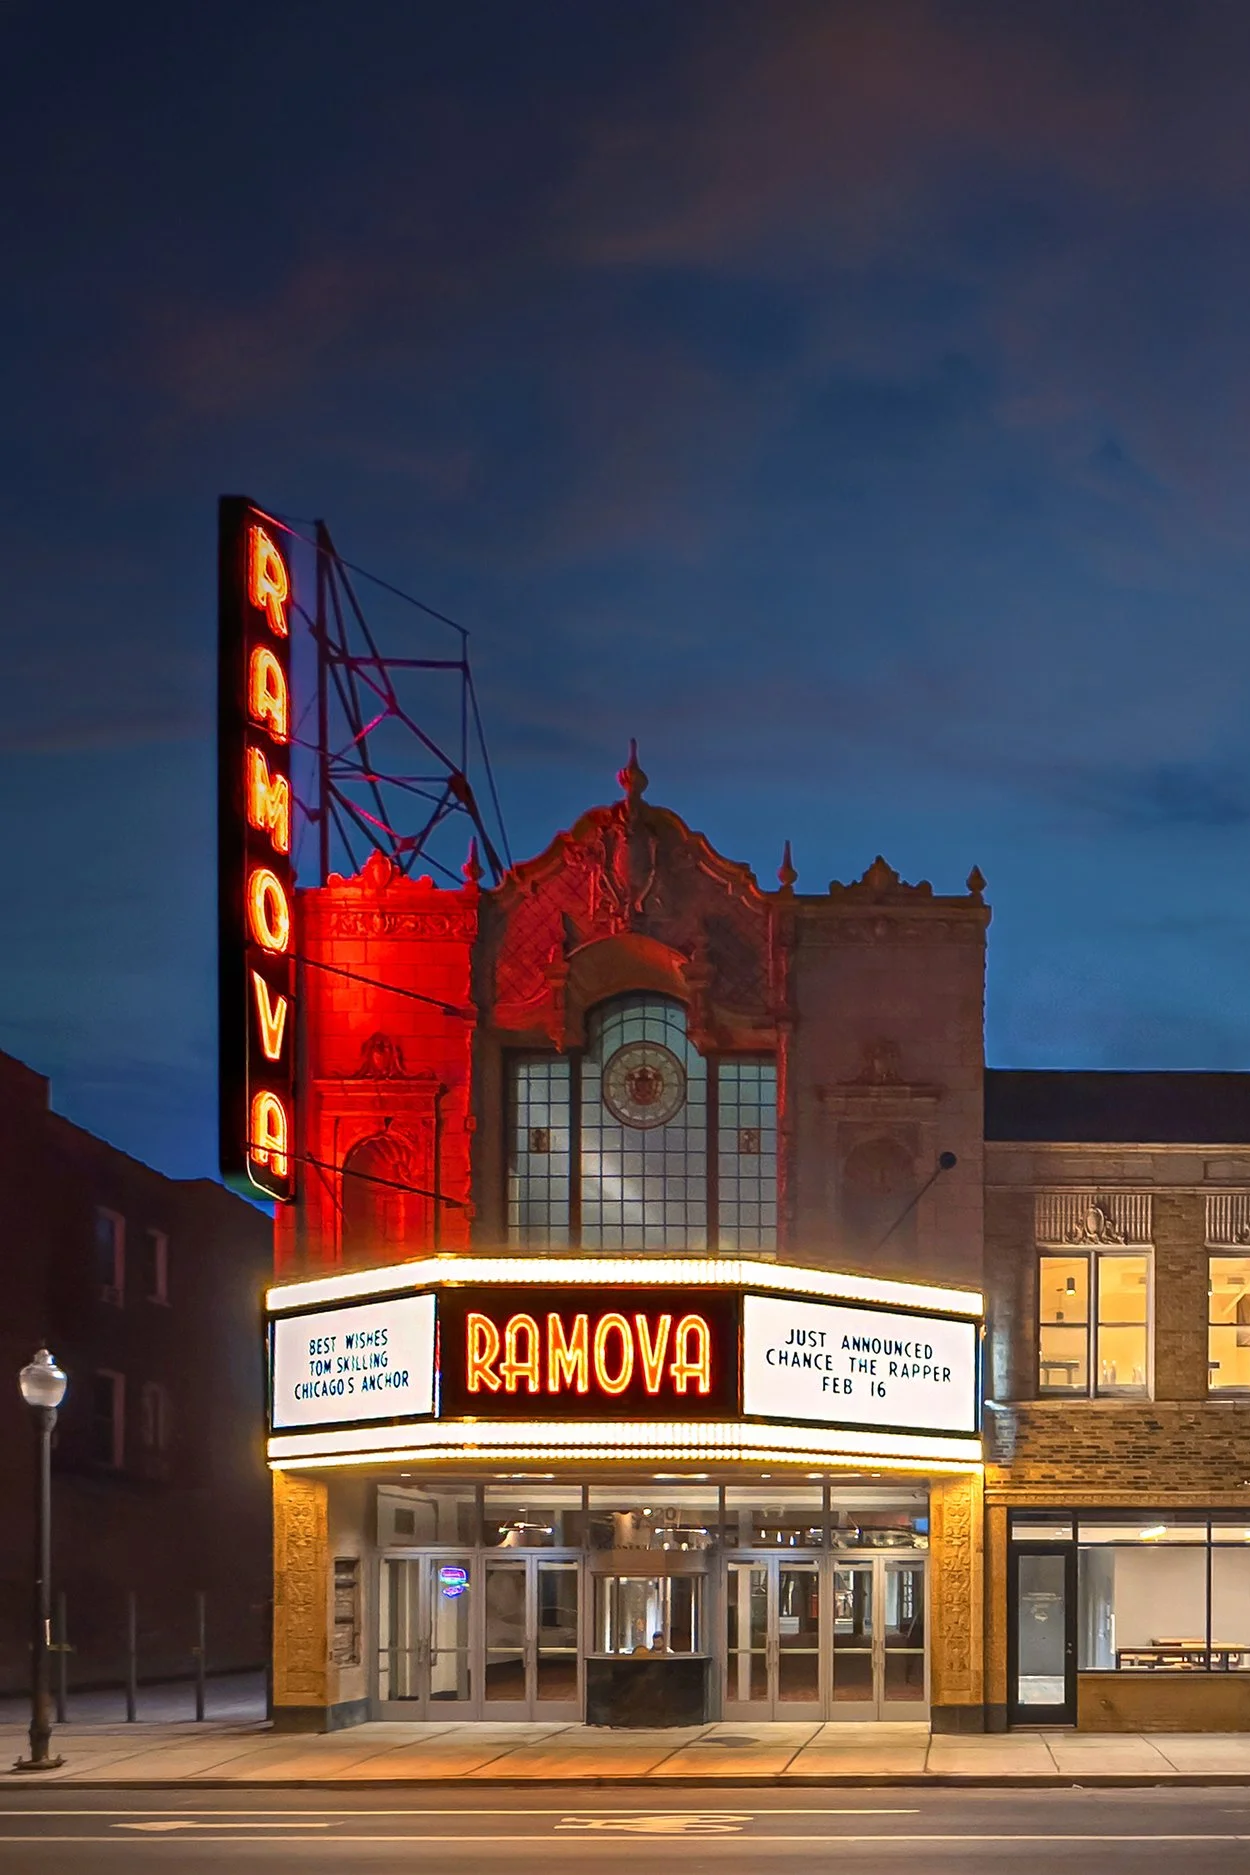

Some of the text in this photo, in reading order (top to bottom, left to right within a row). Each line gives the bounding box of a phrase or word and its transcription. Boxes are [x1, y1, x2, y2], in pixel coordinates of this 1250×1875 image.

[248, 524, 289, 1176] RAMOVA
[309, 1328, 388, 1355] BEST WISHES
[467, 1312, 711, 1394] RAMOVA
[785, 1328, 933, 1360] JUST ANNOUNCED
[309, 1351, 388, 1376] TOM SKILLING
[766, 1348, 951, 1383] CHANCE THE RAPPER
[361, 1370, 409, 1392] ANCHOR
[822, 1376, 886, 1398] FEB 16
